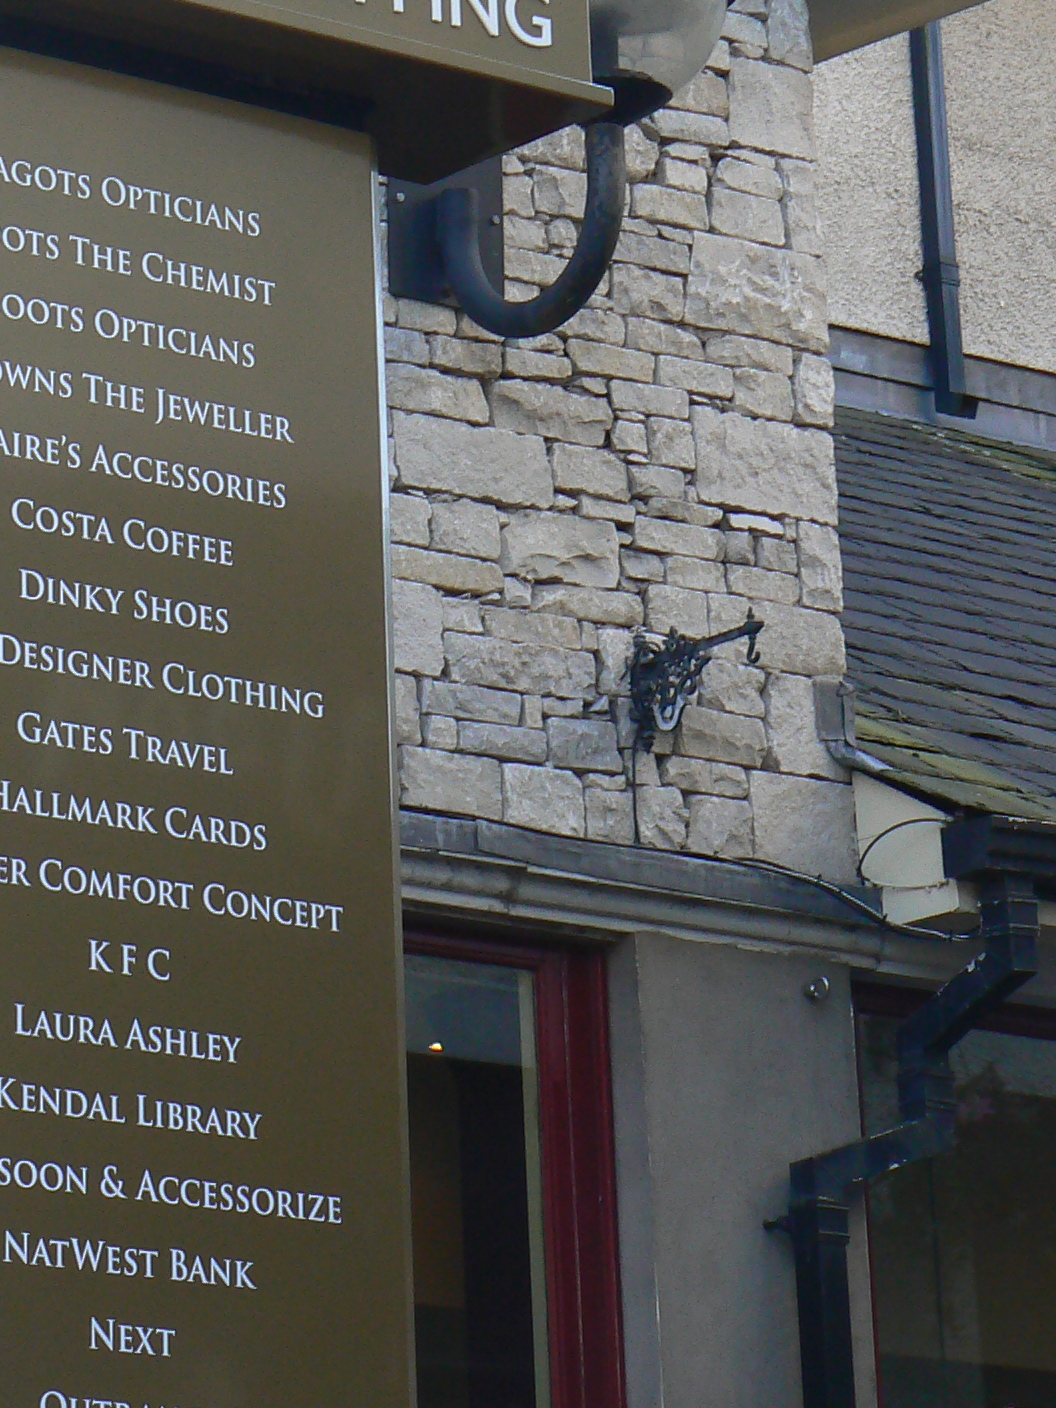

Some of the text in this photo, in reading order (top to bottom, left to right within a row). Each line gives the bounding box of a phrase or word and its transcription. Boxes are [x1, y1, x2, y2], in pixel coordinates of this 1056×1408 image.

[100, 176, 261, 237] OPTICIANS
[68, 234, 132, 277] THE
[141, 252, 276, 307] CHEMIST
[94, 308, 256, 369] OPTICIANS
[81, 372, 146, 414] THE
[154, 387, 295, 444] JEWELLER
[88, 443, 287, 509] ACCESSORIES
[11, 498, 234, 567] COSTA COFFEE
[18, 568, 229, 634] DINKY SHOES
[162, 662, 324, 719] CLOTHING
[16, 711, 234, 776] GATES TRAVEL
[164, 806, 267, 851] CARDS
[39, 858, 194, 910] COMFORT
[202, 883, 344, 932] CONCEPT
[14, 1003, 241, 1064] LAURA ASHLEY
[136, 1094, 263, 1140] LIBRARY
[100, 1165, 128, 1199] &
[134, 1169, 343, 1224] ACCESSORIZE
[169, 1248, 257, 1290] BANK
[89, 1316, 176, 1358] NEXT
